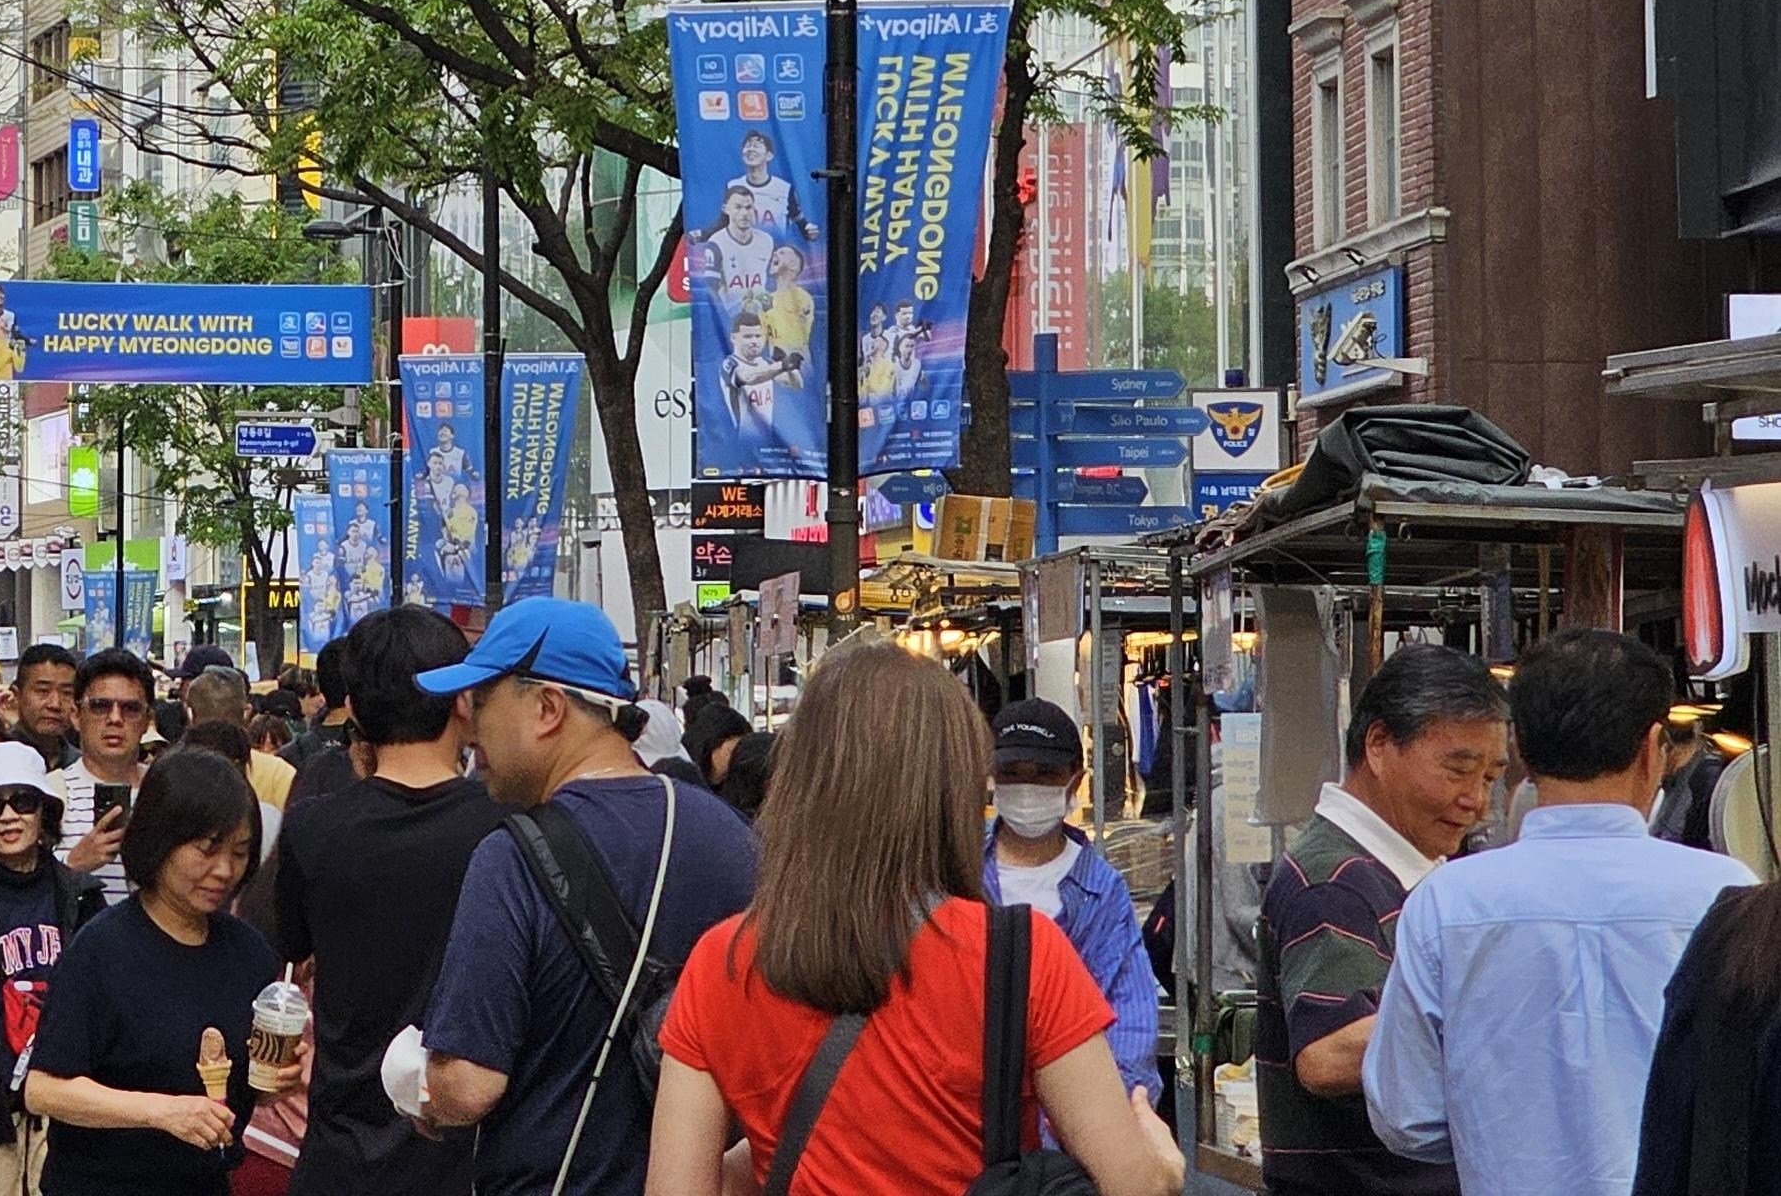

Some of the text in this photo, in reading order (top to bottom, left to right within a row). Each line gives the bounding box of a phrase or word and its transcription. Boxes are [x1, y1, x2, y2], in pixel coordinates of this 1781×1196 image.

[58, 313, 254, 334] LUCKY WALK WITH
[43, 335, 274, 357] HAPPY MYEONGDONG
[1111, 379, 1147, 392] Sydney
[1135, 411, 1168, 426] Paulo
[1223, 440, 1248, 448] POLICE
[1119, 446, 1149, 459] Taipei
[722, 487, 748, 502] WE
[705, 504, 763, 518] 시계거래소
[1129, 515, 1159, 528] Tokyo
[695, 542, 733, 565] 약손
[695, 566, 708, 578] 3F
